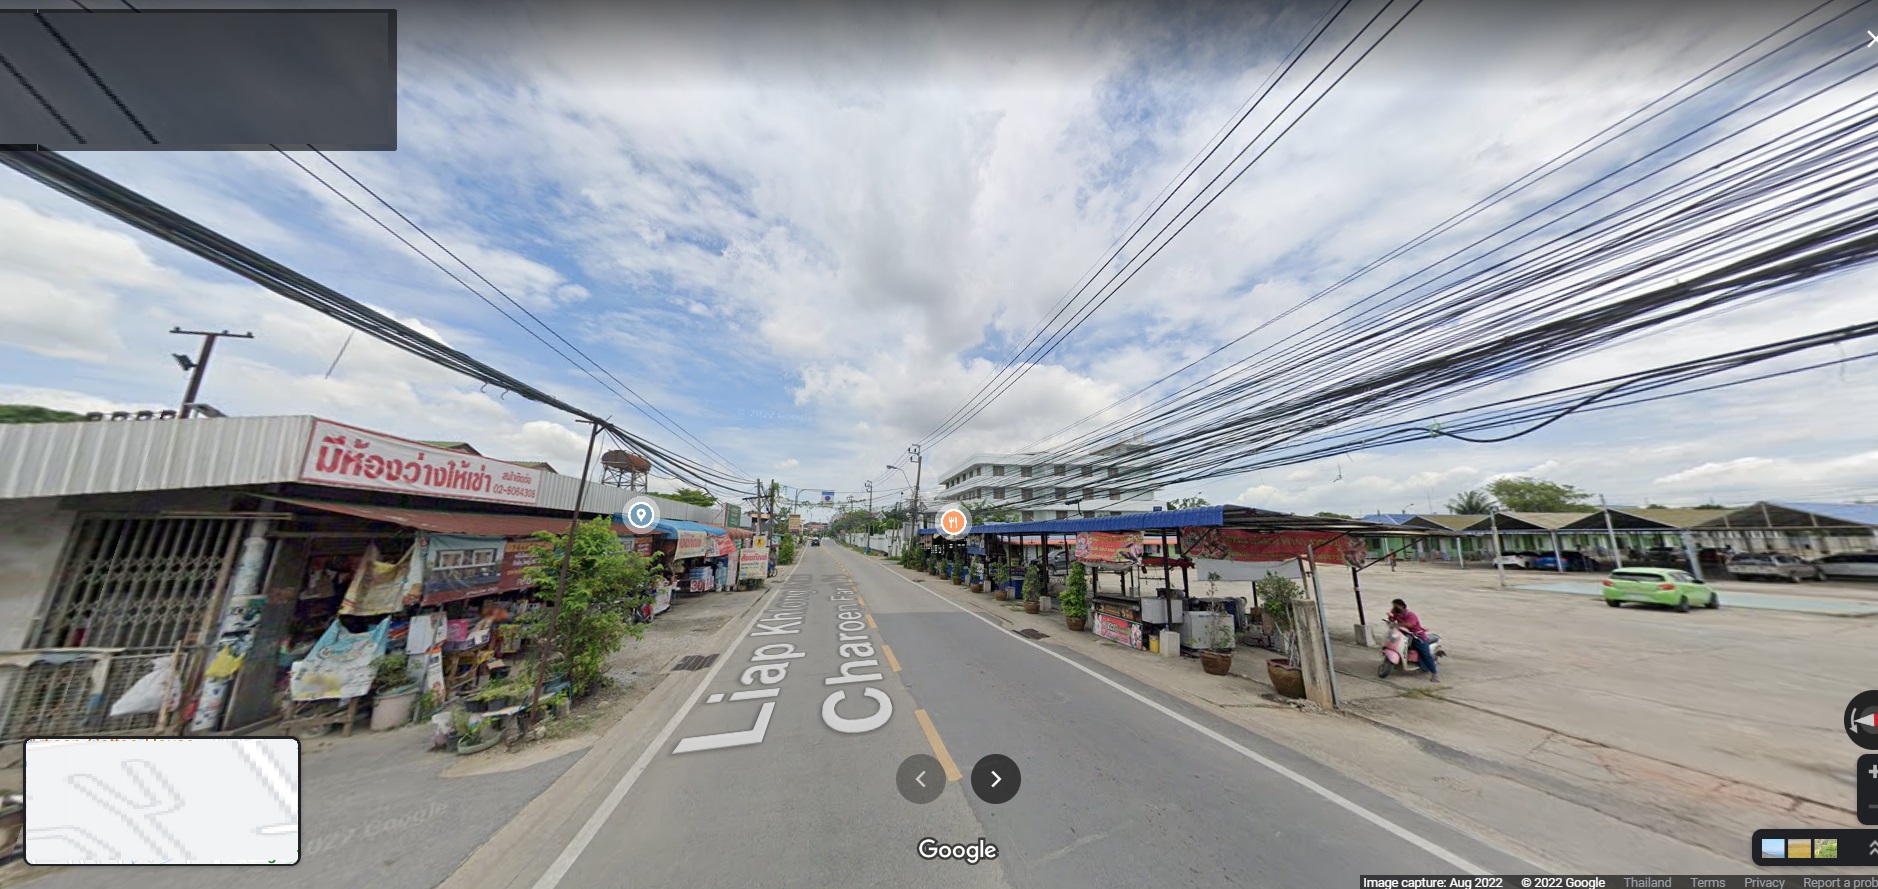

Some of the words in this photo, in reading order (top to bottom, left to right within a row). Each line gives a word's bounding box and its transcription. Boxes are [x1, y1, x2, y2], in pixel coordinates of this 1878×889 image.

[315, 435, 492, 493] มีห้องว่างให้เช่า
